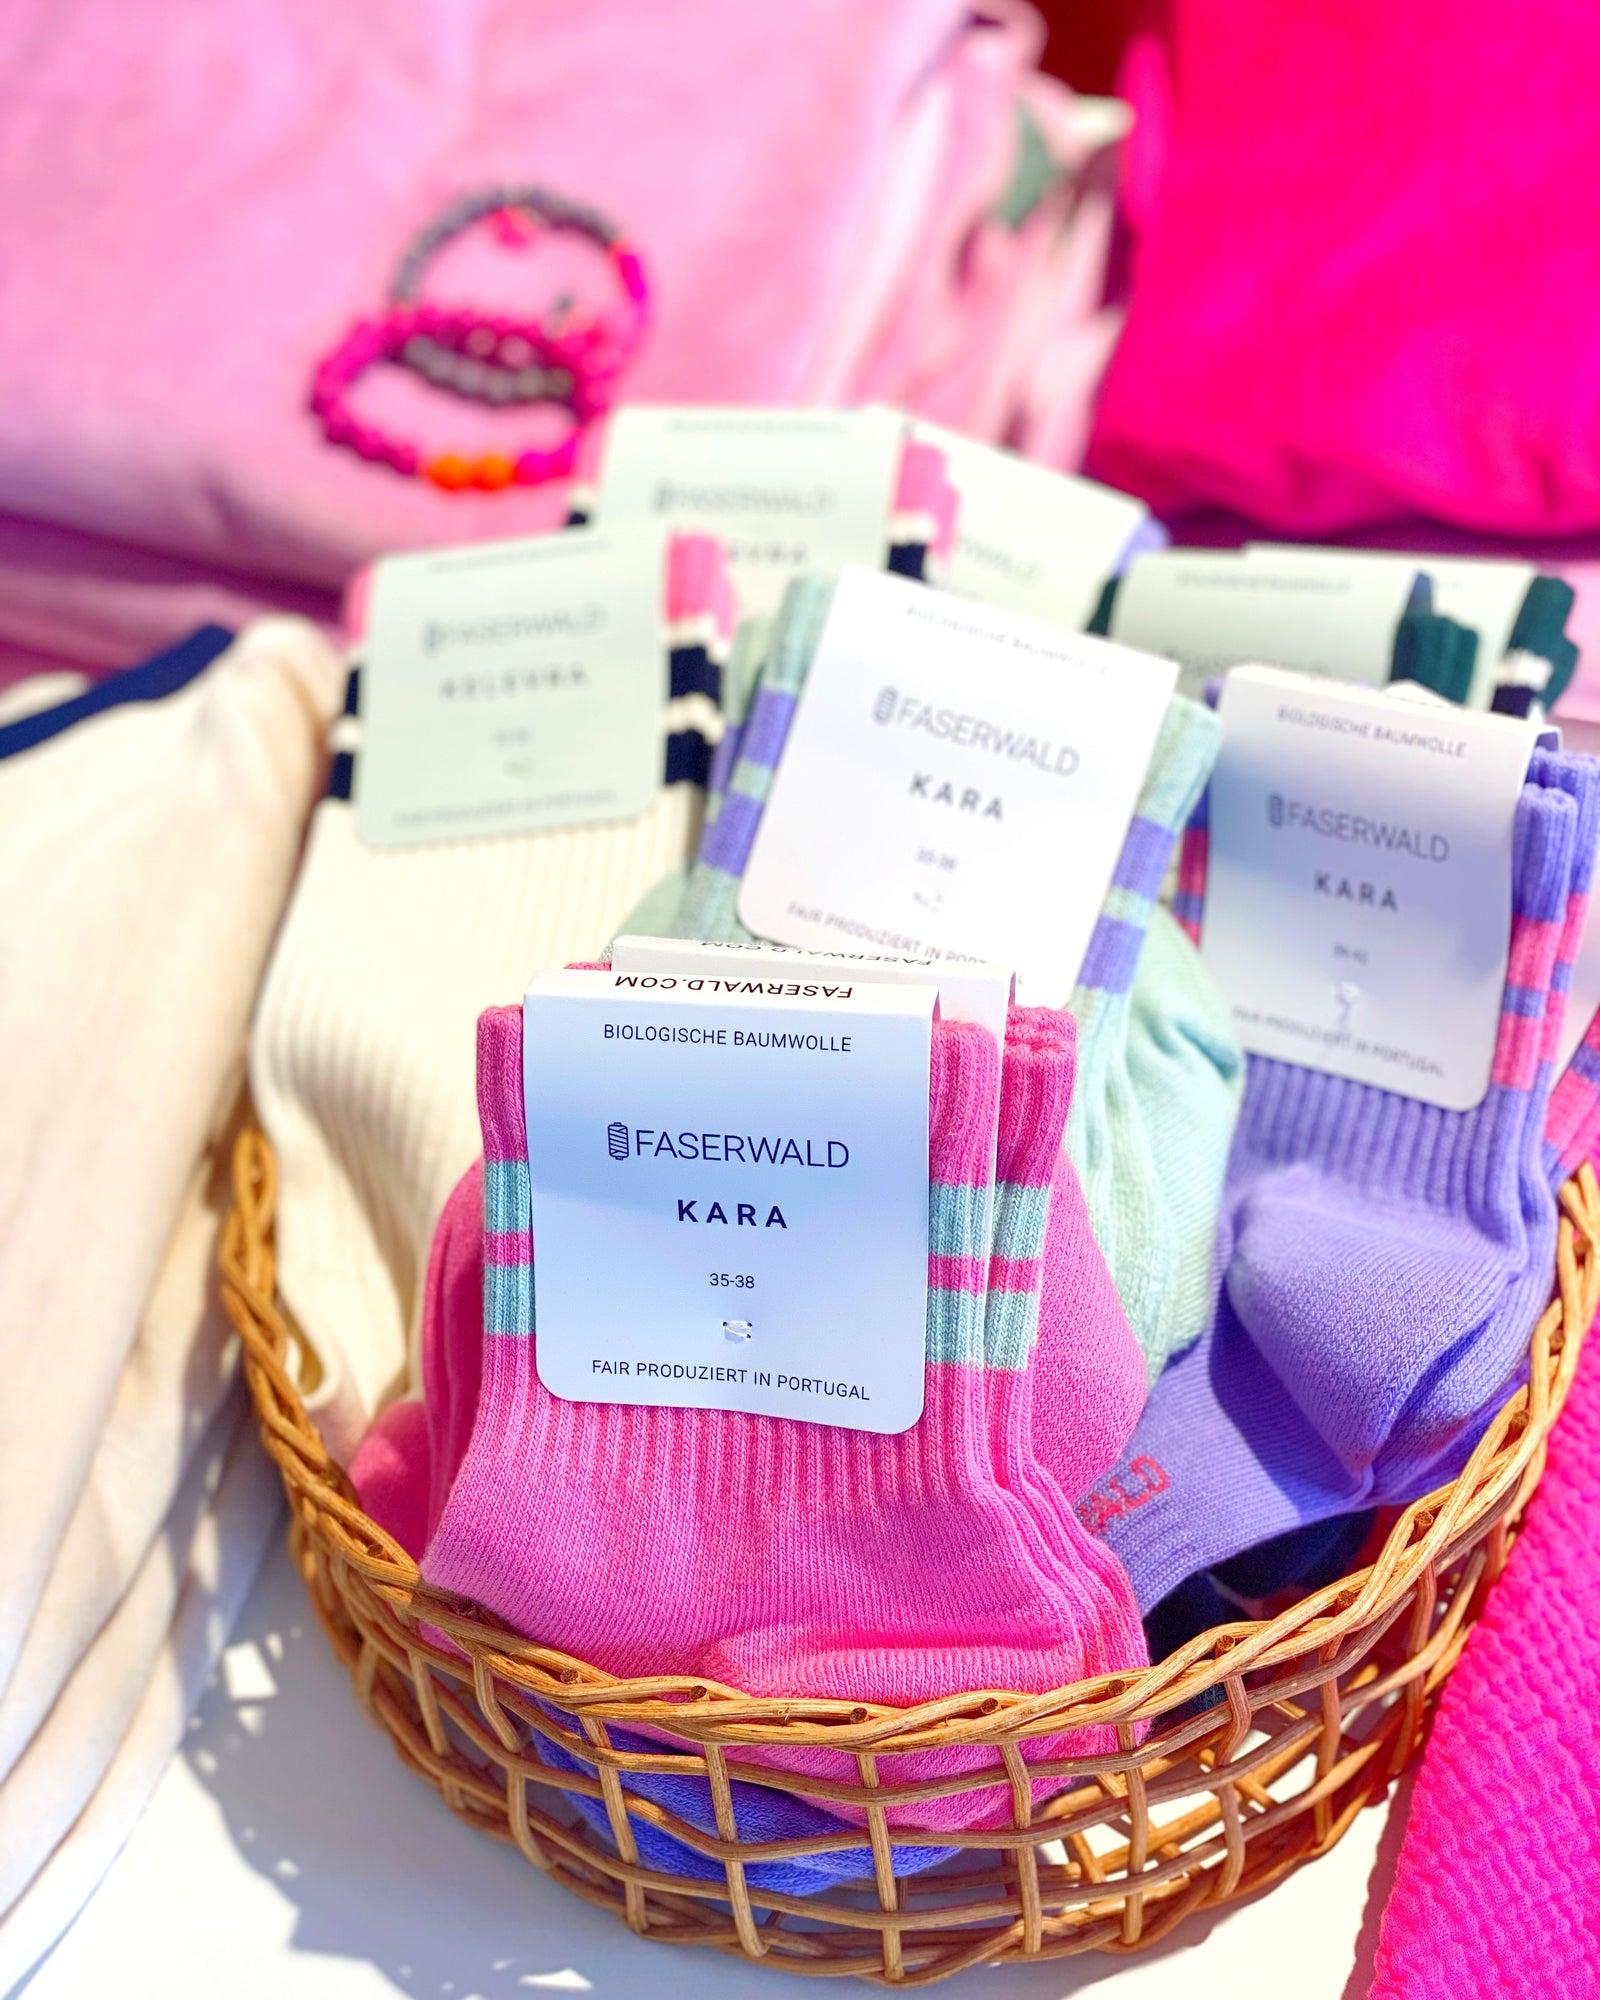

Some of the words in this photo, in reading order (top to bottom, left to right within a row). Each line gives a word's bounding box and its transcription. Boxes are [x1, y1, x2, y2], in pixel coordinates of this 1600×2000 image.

[896, 697, 1080, 777] FASERWALD
[1276, 706, 1369, 738] BIOLOGISCHE
[1372, 726, 1467, 758] BAUMWOLLE
[909, 773, 1004, 820] KARA
[1287, 802, 1450, 863] FASERWALD
[1314, 870, 1399, 912] KARA
[701, 942, 933, 966] FASERWALDCOM
[925, 945, 942, 961] IN
[614, 975, 852, 999] FASERWALD.COM
[603, 1024, 728, 1046] BIOLOGISCHE
[733, 1031, 853, 1052] BAUMWOLLE
[635, 1129, 850, 1168] FASERWALD
[677, 1199, 788, 1229] KARA
[709, 1272, 756, 1289] 35-38
[592, 1360, 630, 1376] FAIR
[636, 1363, 748, 1383] PRODUZIERT
[754, 1372, 771, 1387] IN
[777, 1375, 870, 1400] PORTUGAL
